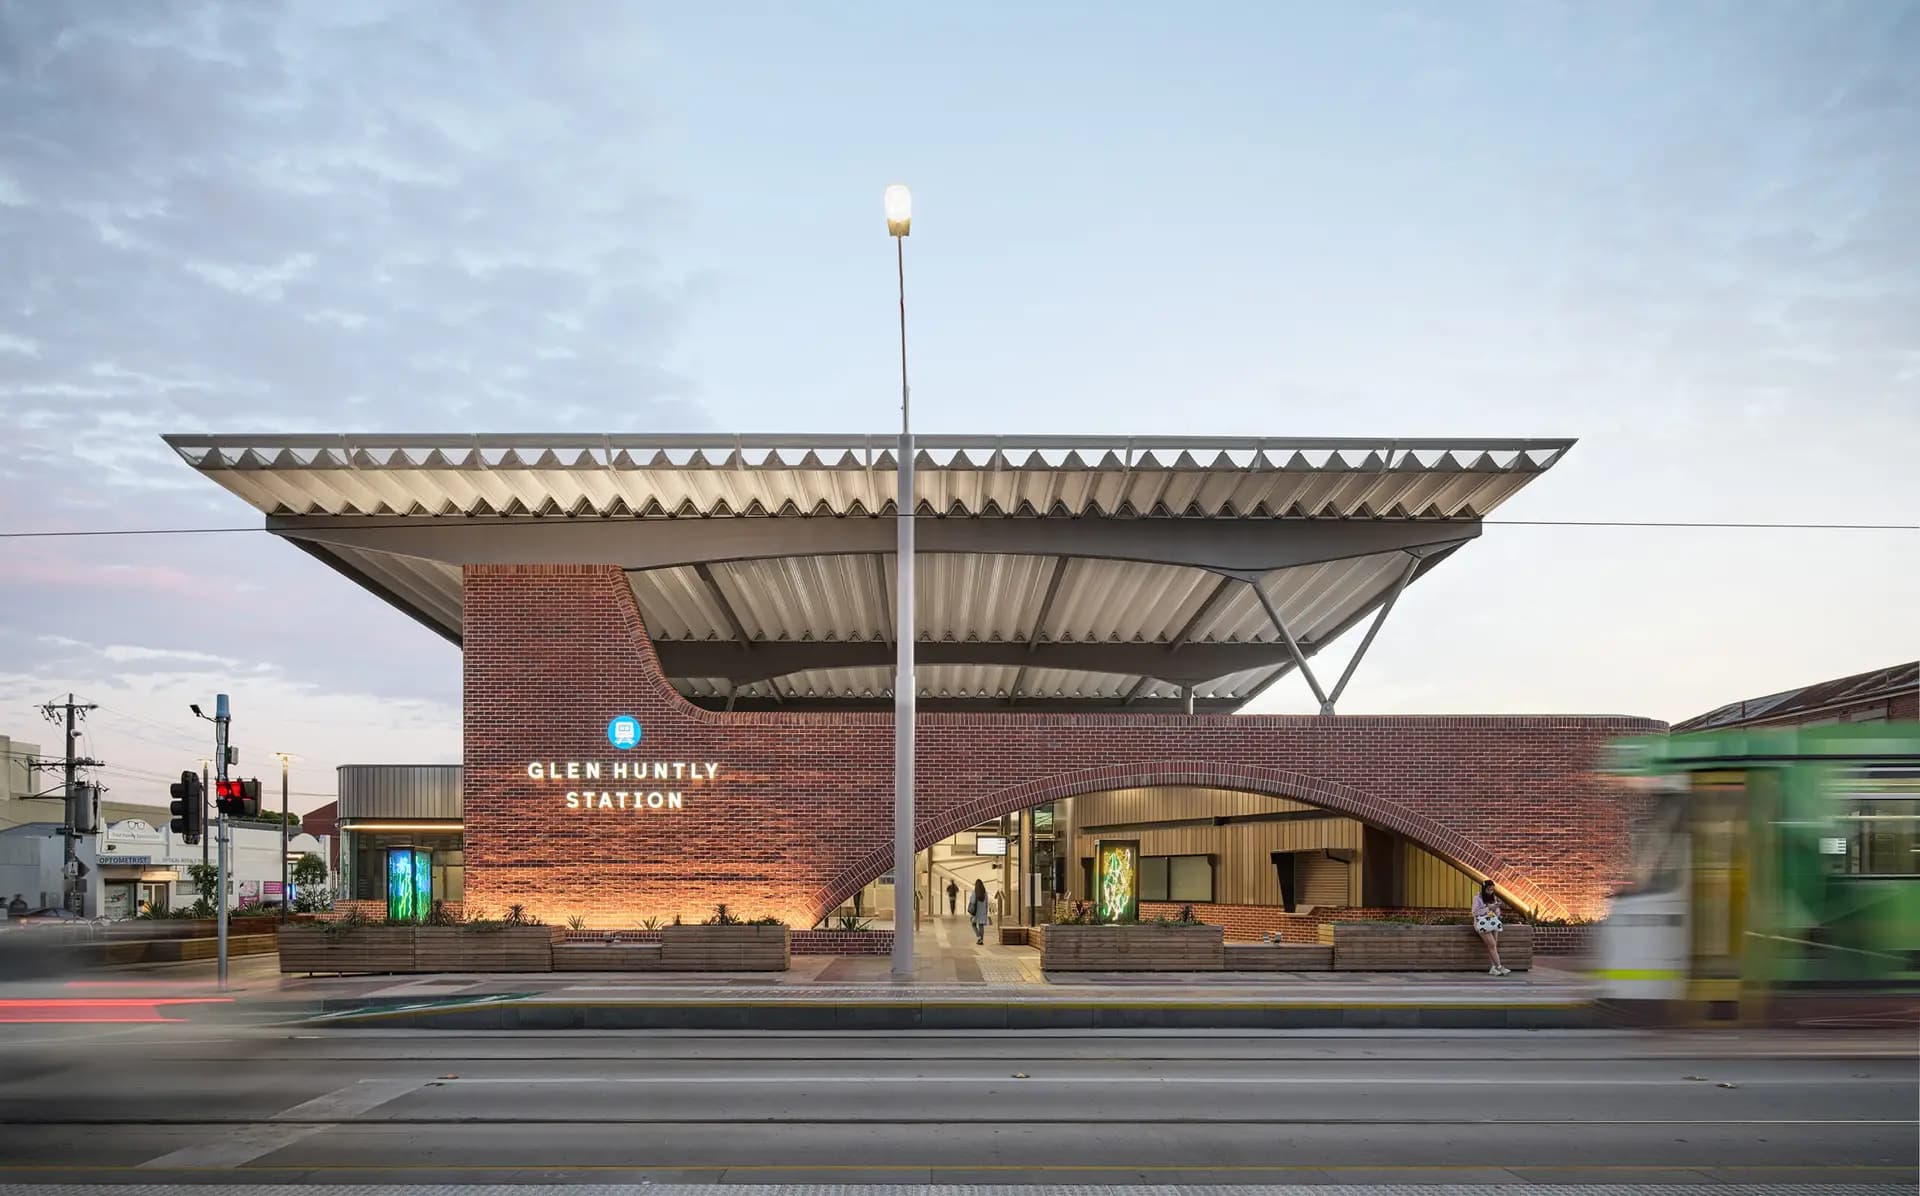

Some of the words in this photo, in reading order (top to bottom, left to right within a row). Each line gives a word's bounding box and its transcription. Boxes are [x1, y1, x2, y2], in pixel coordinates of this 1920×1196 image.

[528, 762, 600, 779] GLEN
[614, 762, 718, 779] HUNTLY
[566, 791, 682, 808] STATION
[99, 856, 147, 864] OPTOMETRIST
